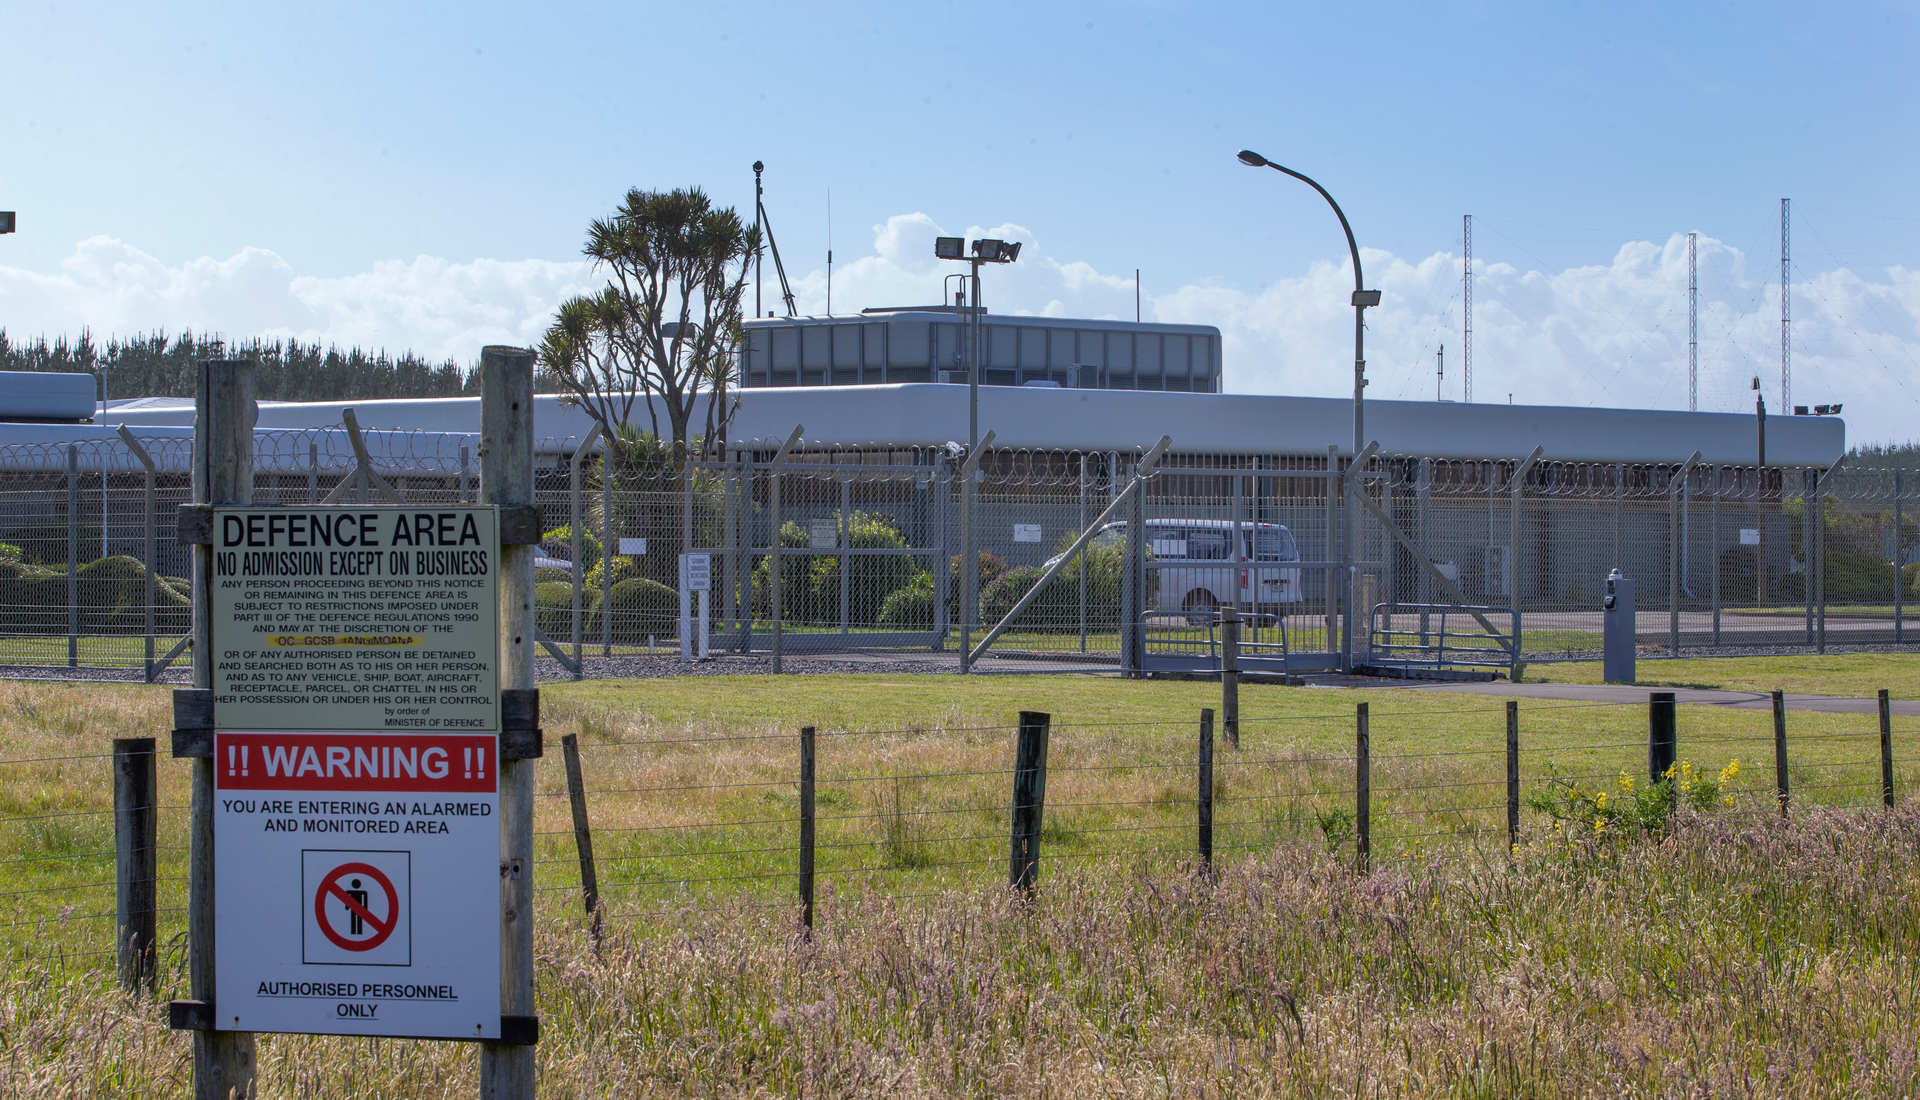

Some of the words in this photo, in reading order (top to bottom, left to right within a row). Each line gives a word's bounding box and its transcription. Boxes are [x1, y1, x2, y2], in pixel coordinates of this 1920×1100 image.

[224, 514, 378, 547] DEFENCE
[392, 514, 480, 546] AREA
[218, 552, 236, 576] NO
[242, 552, 322, 576] ADMISSION
[330, 551, 383, 575] EXCEPT
[390, 551, 409, 575] ON
[417, 551, 487, 575] BUSINESS
[222, 580, 242, 588] ANY
[246, 580, 290, 588] PERSON
[294, 580, 364, 588] PROCEEDING
[369, 580, 413, 588] BEYOND
[264, 591, 324, 599] REMAINING
[342, 591, 366, 599] THIS
[370, 591, 421, 599] DEFENCE
[458, 591, 468, 599] IS
[234, 602, 283, 610] SUBJECT
[288, 602, 302, 610] TO
[306, 602, 384, 610] RESTRICTIONS
[388, 602, 437, 610] IMPOSED
[441, 602, 478, 610] UNDER
[304, 636, 335, 645] GCSB
[423, 651, 475, 659] DETAINED
[218, 662, 241, 670] AND
[244, 662, 303, 670] SEARCHED
[307, 662, 336, 670] BOTH
[340, 662, 354, 670] AS
[357, 662, 371, 670] TO
[376, 662, 393, 670] HIS
[442, 663, 489, 671] PERSON,
[251, 673, 265, 681] AS
[312, 674, 360, 682] VEHICLE,
[364, 674, 390, 682] SHIP,
[395, 674, 423, 682] BOAT,
[427, 674, 482, 682] AIRCRAFT,
[231, 684, 302, 693] RECEPTACLE,
[306, 685, 350, 693] PARCEL,
[440, 685, 457, 693] HIS
[461, 685, 476, 693] OR
[374, 696, 391, 704] HIS
[395, 696, 410, 704] OR
[414, 696, 436, 704] HER
[440, 696, 492, 704] CONTROL
[385, 707, 394, 716] by
[444, 719, 484, 727] DEFENCE
[229, 746, 248, 776] !!
[262, 746, 448, 779] WARNING
[464, 748, 484, 778] !!
[223, 800, 255, 813] YOU
[260, 801, 293, 813] ARE
[299, 801, 379, 814] ENTERING
[384, 802, 406, 815] AN
[411, 803, 491, 816] ALARMED
[264, 819, 298, 832] AND
[304, 820, 399, 833] MONITORED
[404, 821, 449, 834] AREA
[257, 982, 357, 995] AUTHORISED
[363, 984, 458, 998] PERSONNEL
[337, 1004, 378, 1017] ONLY
